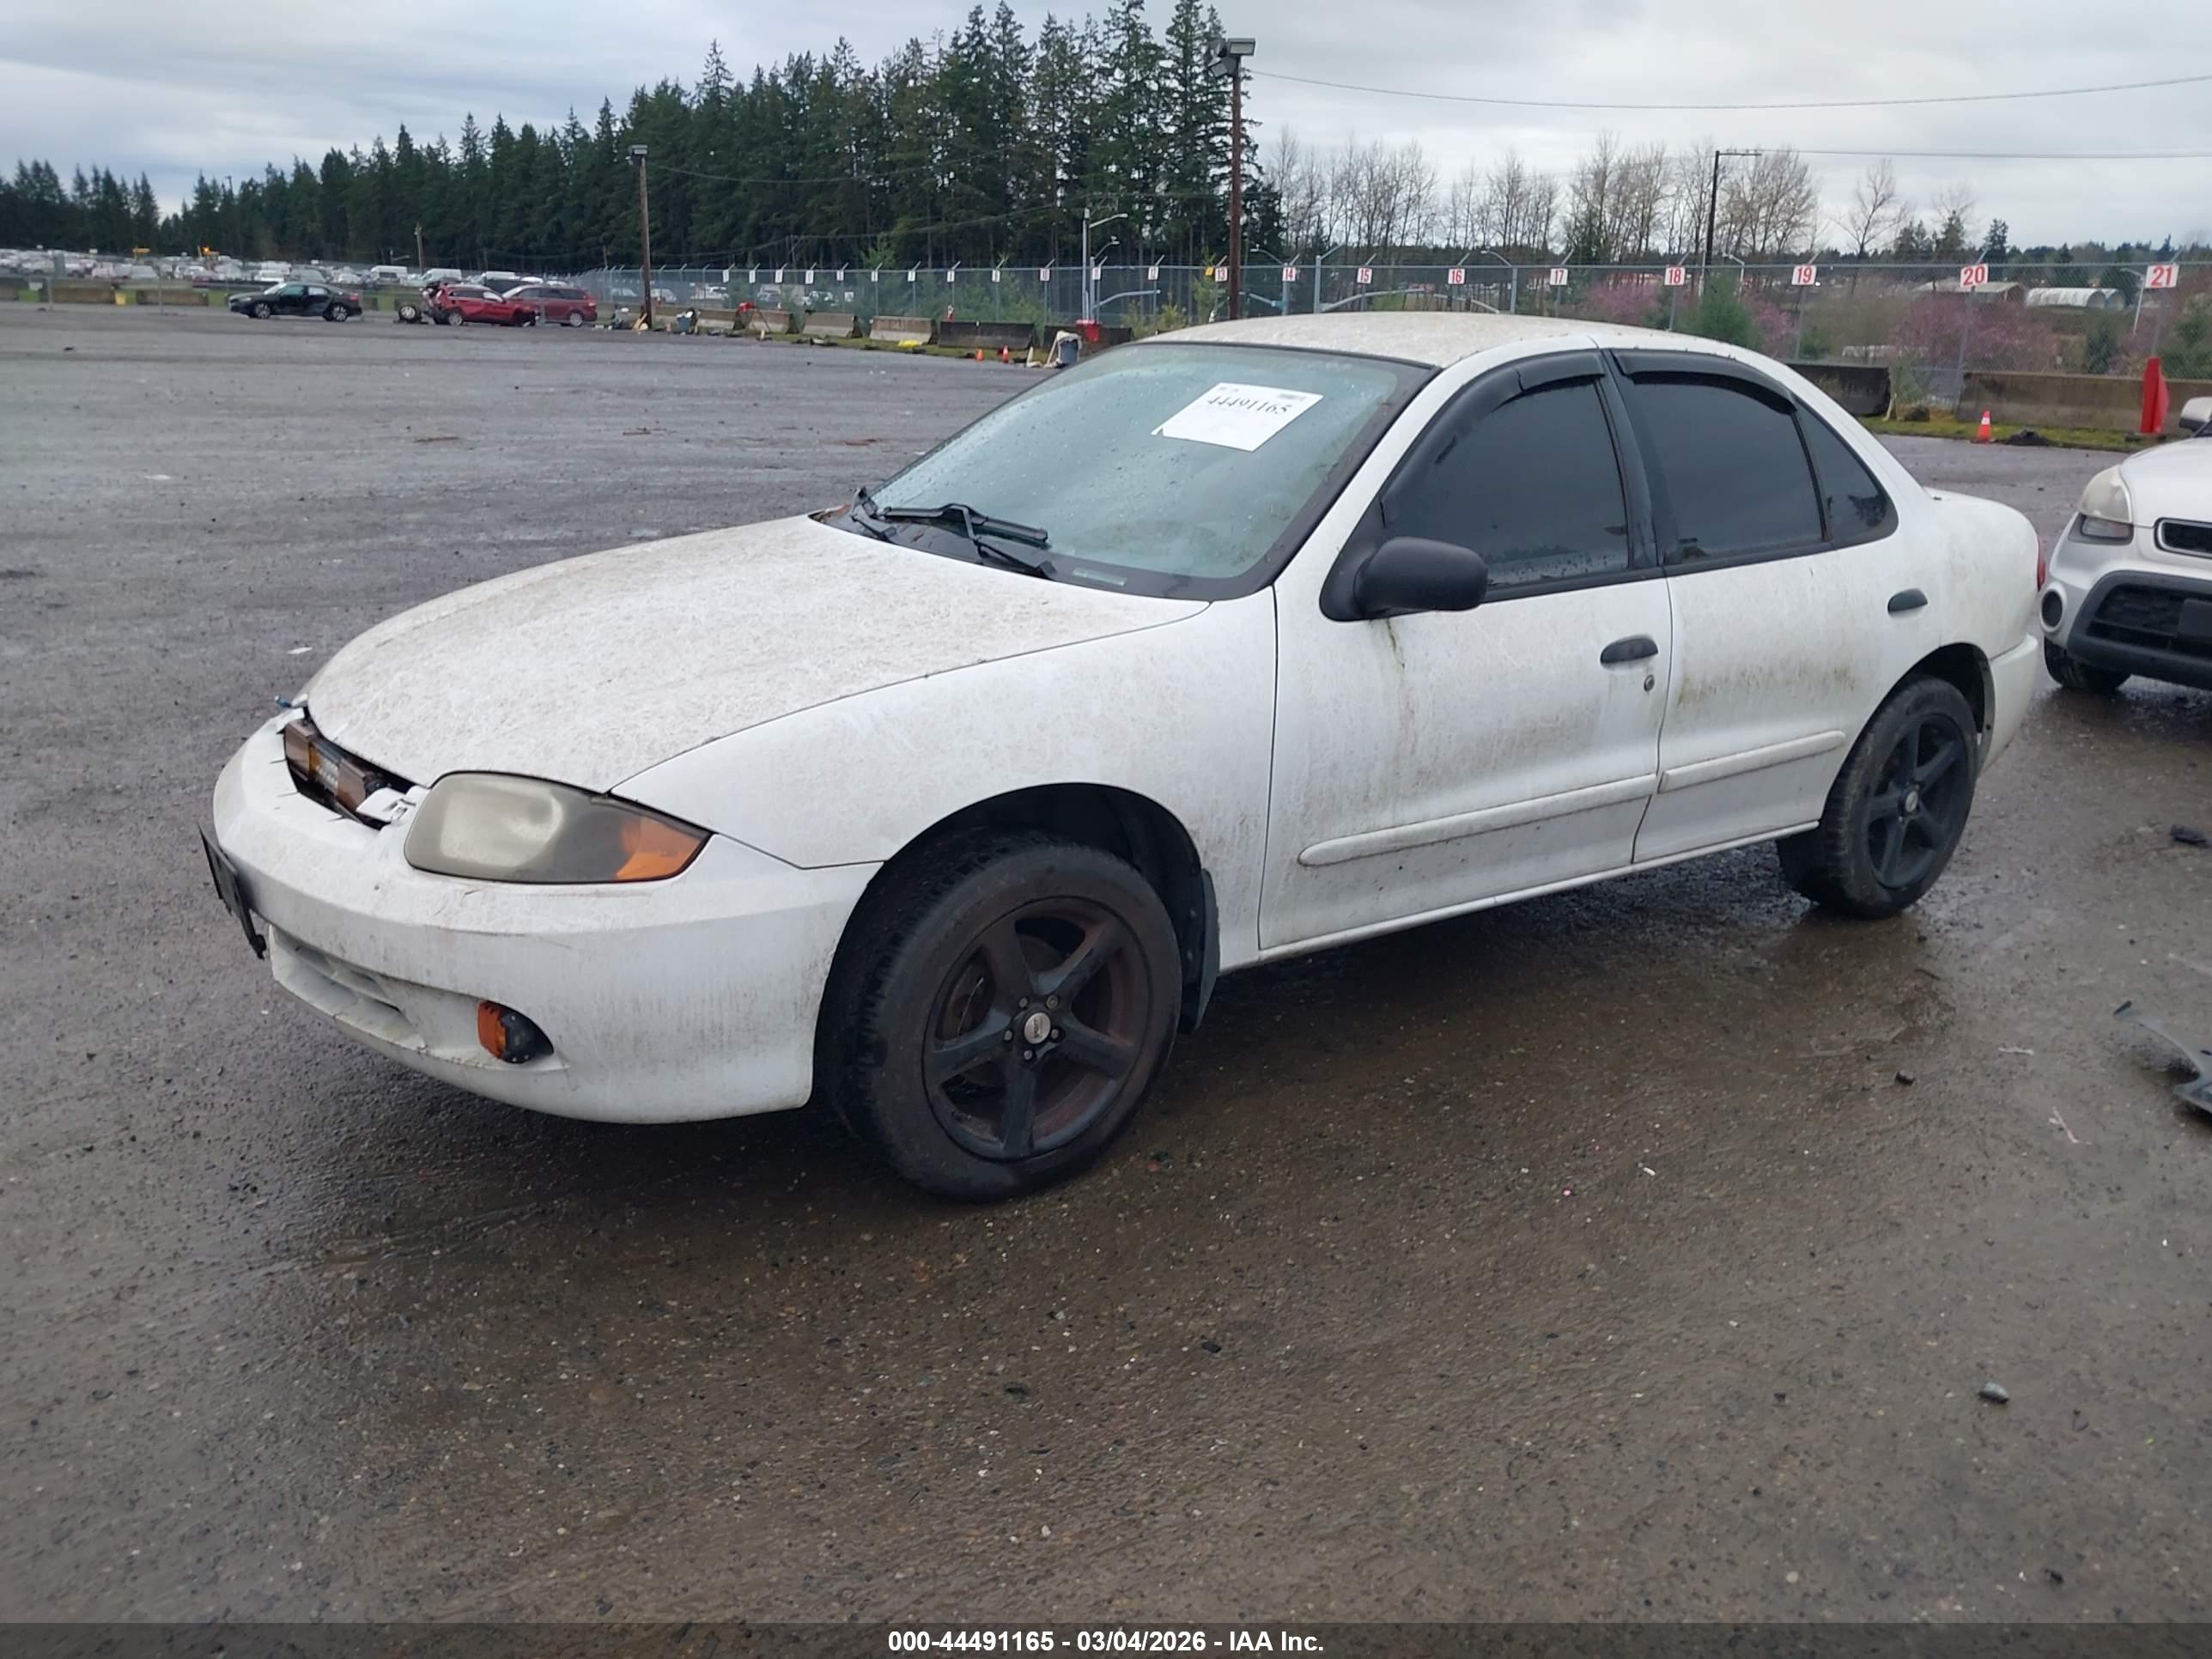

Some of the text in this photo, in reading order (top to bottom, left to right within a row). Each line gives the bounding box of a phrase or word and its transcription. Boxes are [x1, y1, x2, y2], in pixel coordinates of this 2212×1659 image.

[1217, 268, 1225, 281] 13
[1285, 268, 1293, 280] 14
[1360, 268, 1370, 281] 15
[1451, 269, 1462, 283] 16
[1555, 269, 1565, 283] 17
[1668, 268, 1682, 284] 18
[1797, 267, 1813, 284] 19
[1964, 265, 1985, 287] 20
[2151, 265, 2172, 287] 21
[1207, 396, 1292, 414] 44491165
